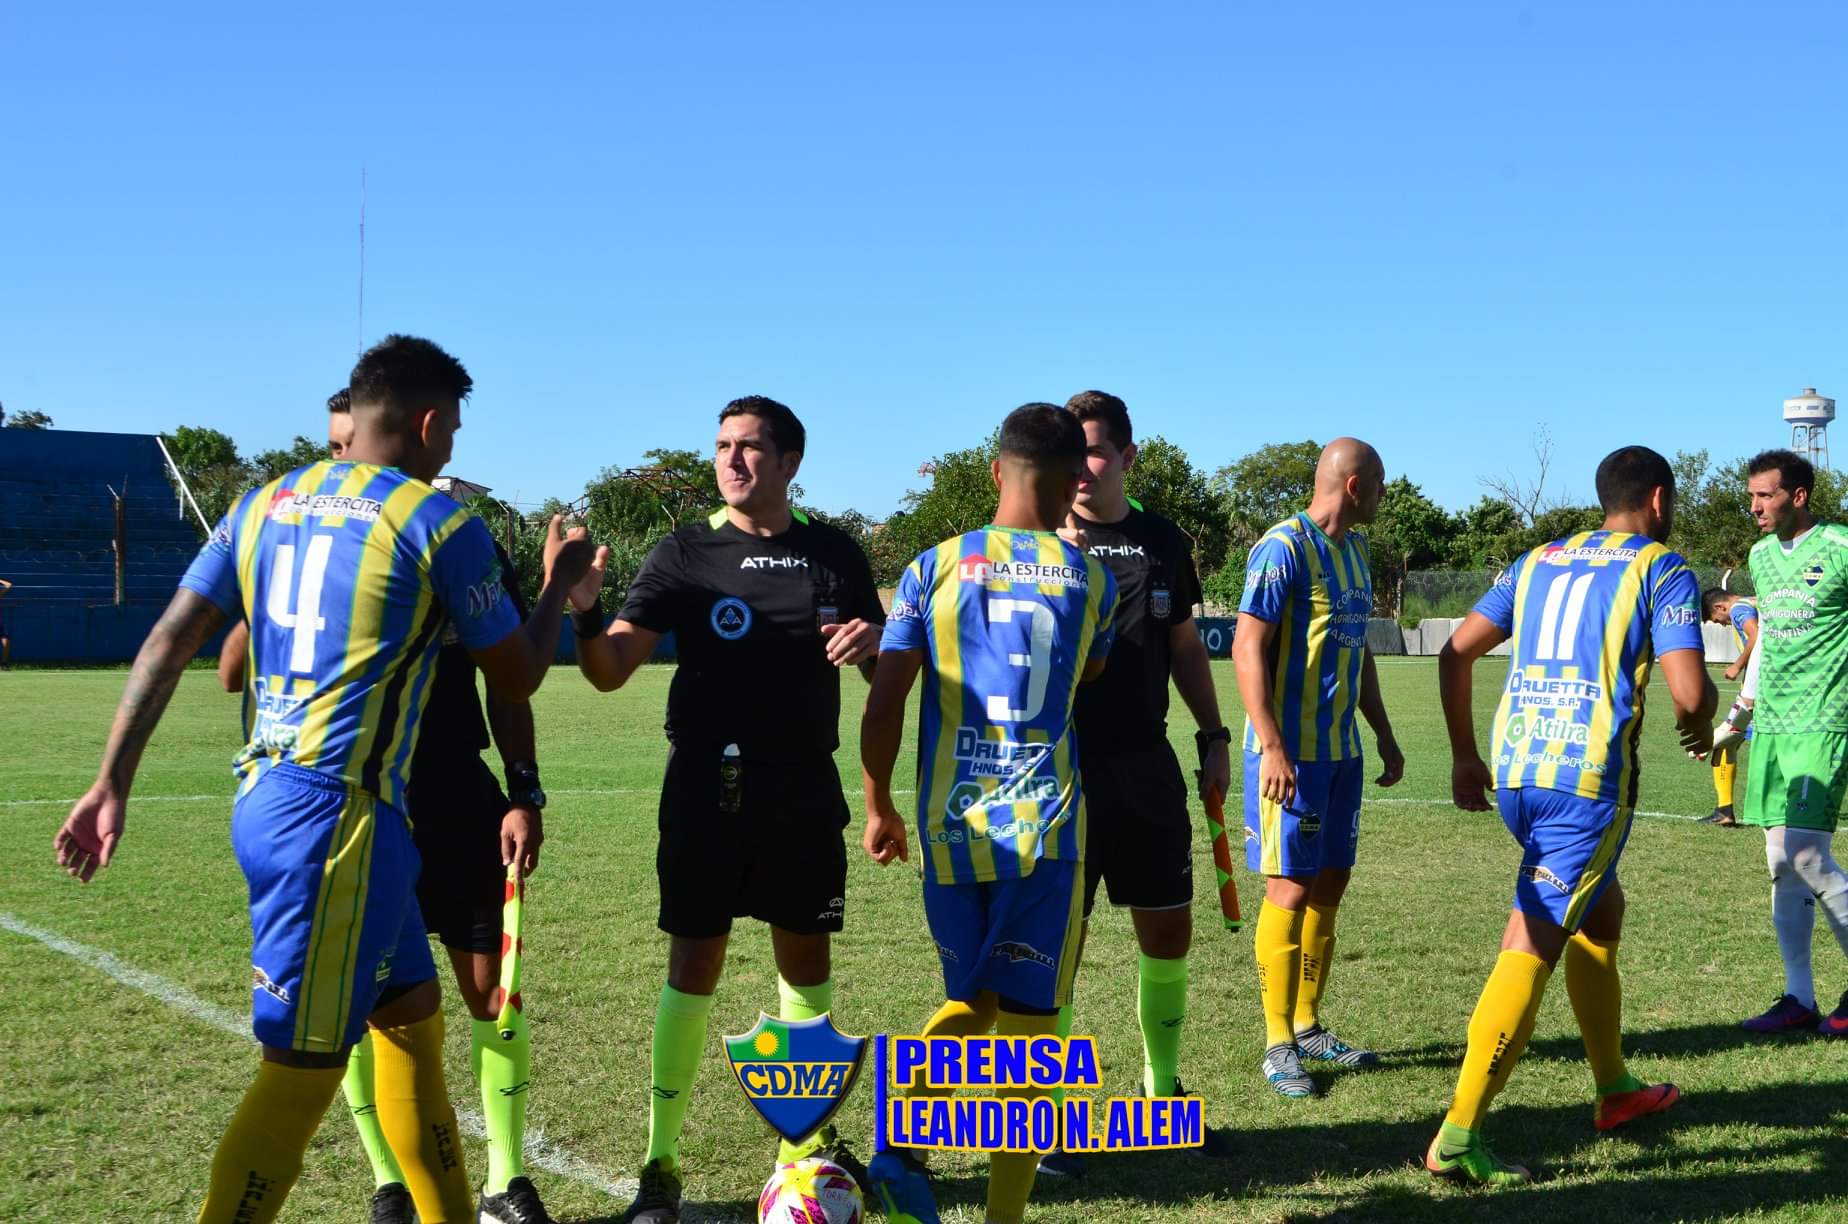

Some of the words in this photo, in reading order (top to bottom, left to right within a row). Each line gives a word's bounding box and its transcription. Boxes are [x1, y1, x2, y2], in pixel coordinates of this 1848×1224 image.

[293, 493, 310, 506] LA
[313, 495, 382, 516] ESTERCITA
[740, 556, 809, 569] ATHIX
[1563, 547, 1577, 555] LA
[1579, 548, 1638, 559] ESTERCITA
[992, 575, 1089, 590] construccion
[993, 561, 1011, 575] LA
[1016, 562, 1089, 587] ESTERCITA
[267, 535, 333, 673] 4
[1535, 571, 1596, 661] 11
[988, 598, 1055, 722] 3
[1509, 670, 1601, 701] DRUETTA
[1528, 715, 1588, 743] Atilra
[1514, 751, 1608, 776] Lecheros
[817, 911, 842, 920] ATH
